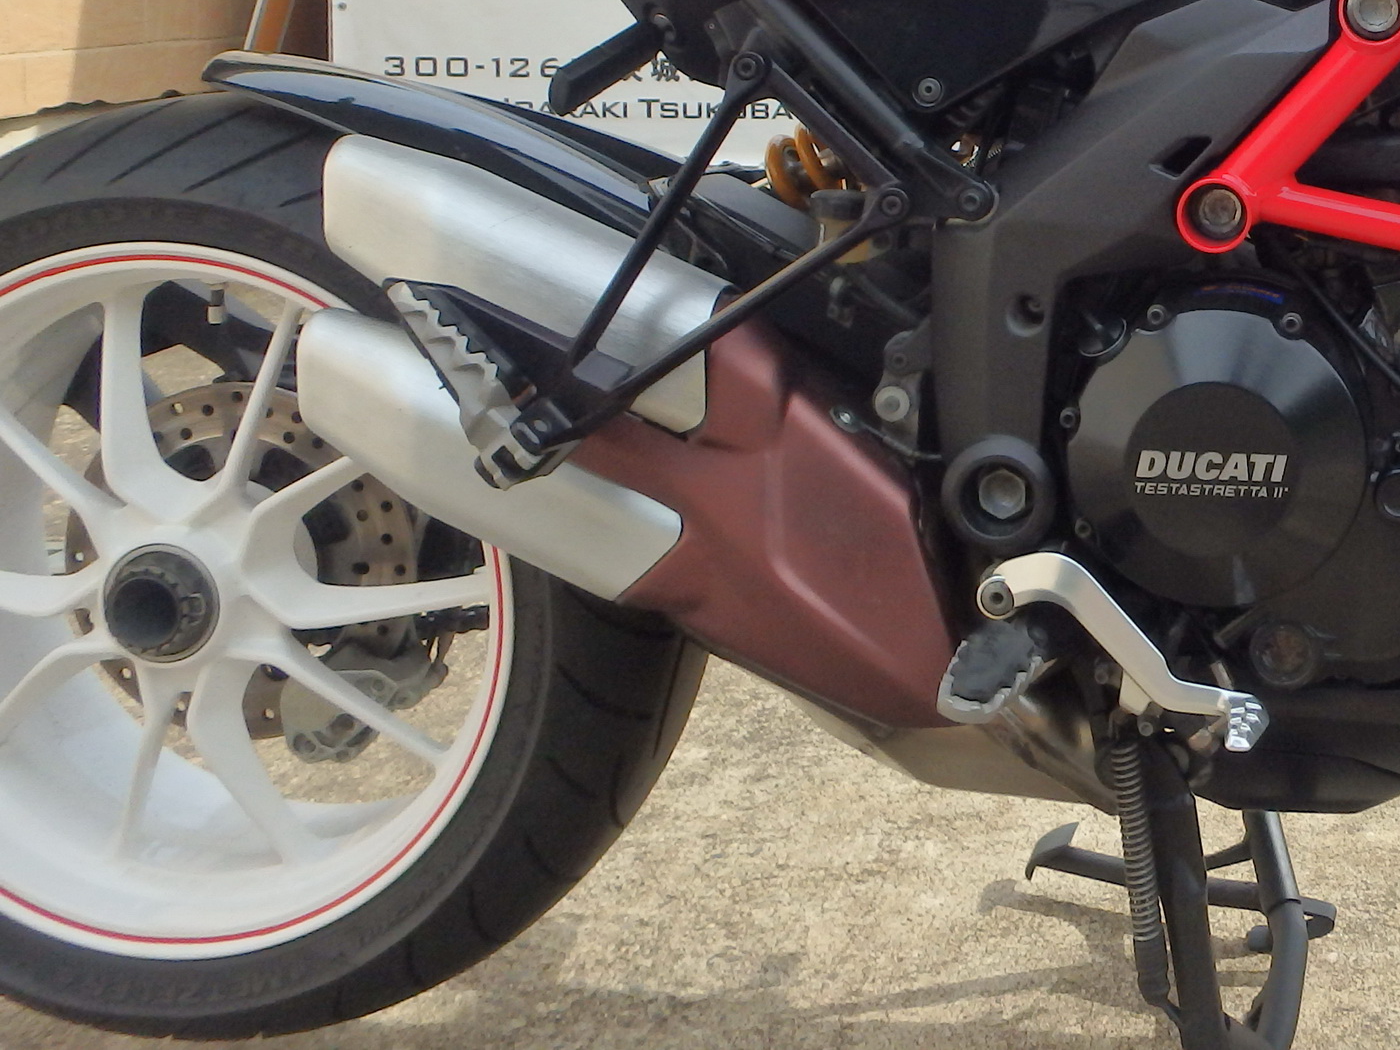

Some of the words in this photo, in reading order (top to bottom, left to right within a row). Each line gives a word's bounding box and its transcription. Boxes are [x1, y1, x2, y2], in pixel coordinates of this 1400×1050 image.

[384, 55, 576, 79] 300-126
[1136, 450, 1287, 482] DUCATI
[1135, 482, 1267, 497] TESTASTRETTA
